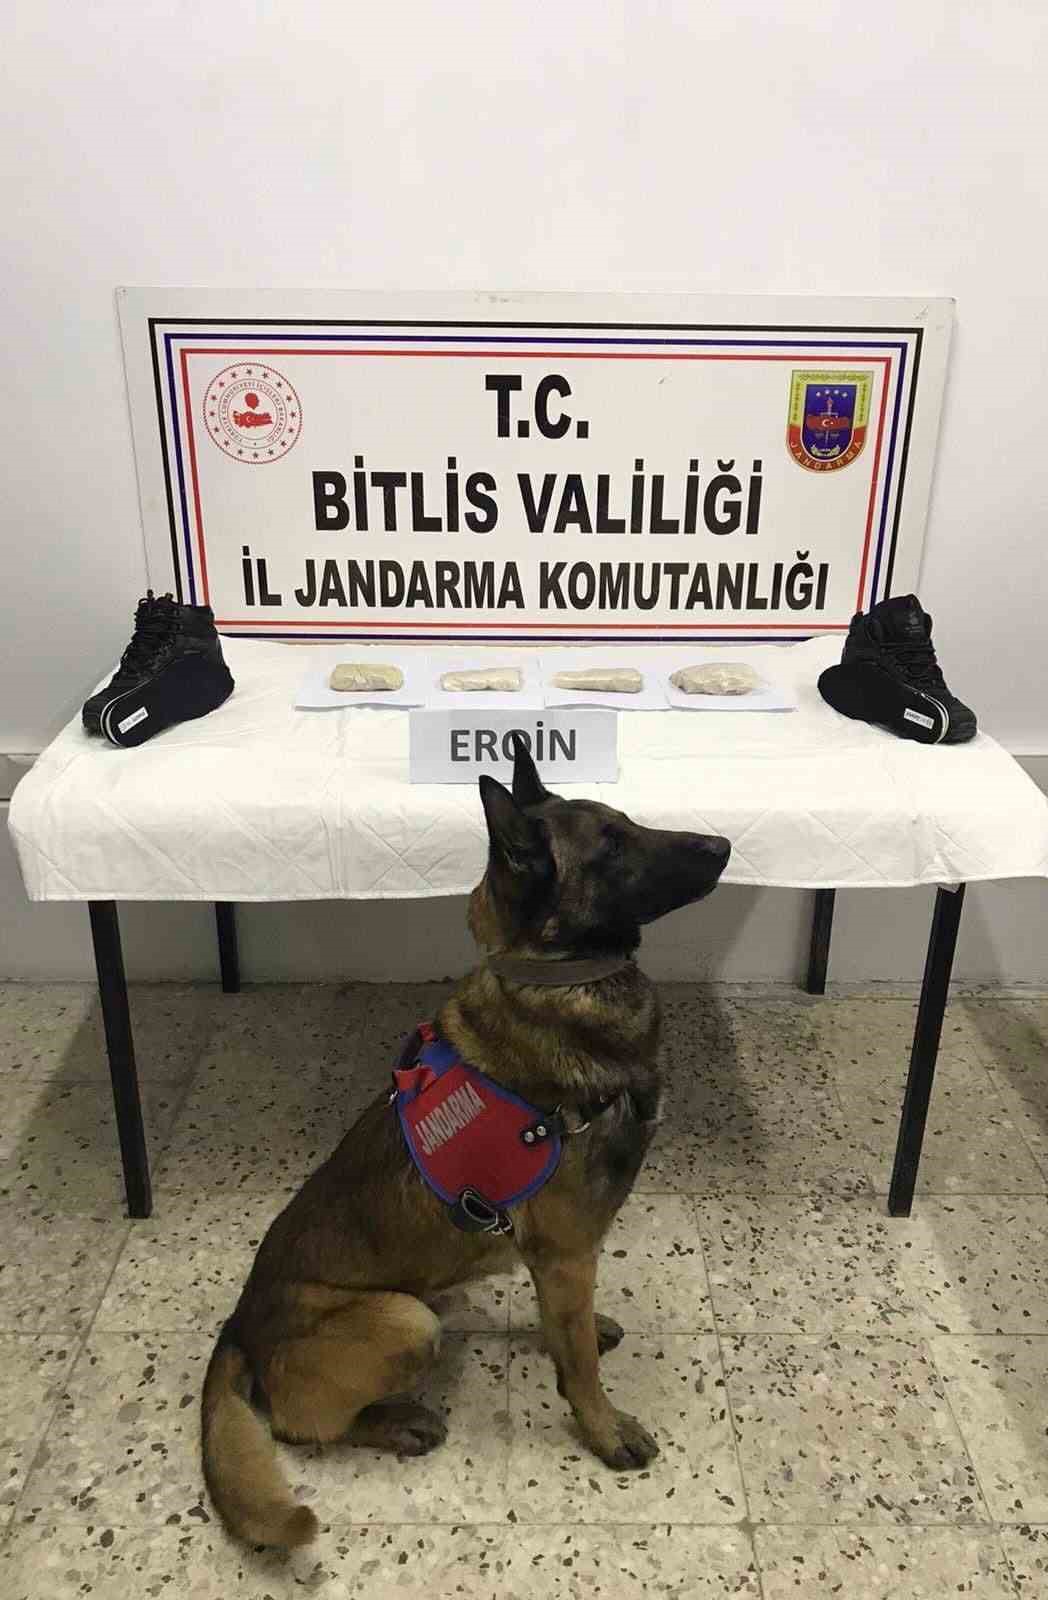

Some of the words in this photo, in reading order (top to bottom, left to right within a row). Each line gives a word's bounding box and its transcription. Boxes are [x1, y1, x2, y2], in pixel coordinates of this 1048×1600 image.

[486, 375, 590, 441] T.C.
[789, 441, 863, 470] JANDARMA
[313, 456, 500, 535] BİTLİS
[518, 459, 764, 537] VALİLİĞİ
[243, 546, 283, 607] İL
[295, 560, 526, 610] JANDARMA
[540, 551, 830, 612] KOMUTANLIĞI
[415, 1081, 487, 1156] JANDARMA
